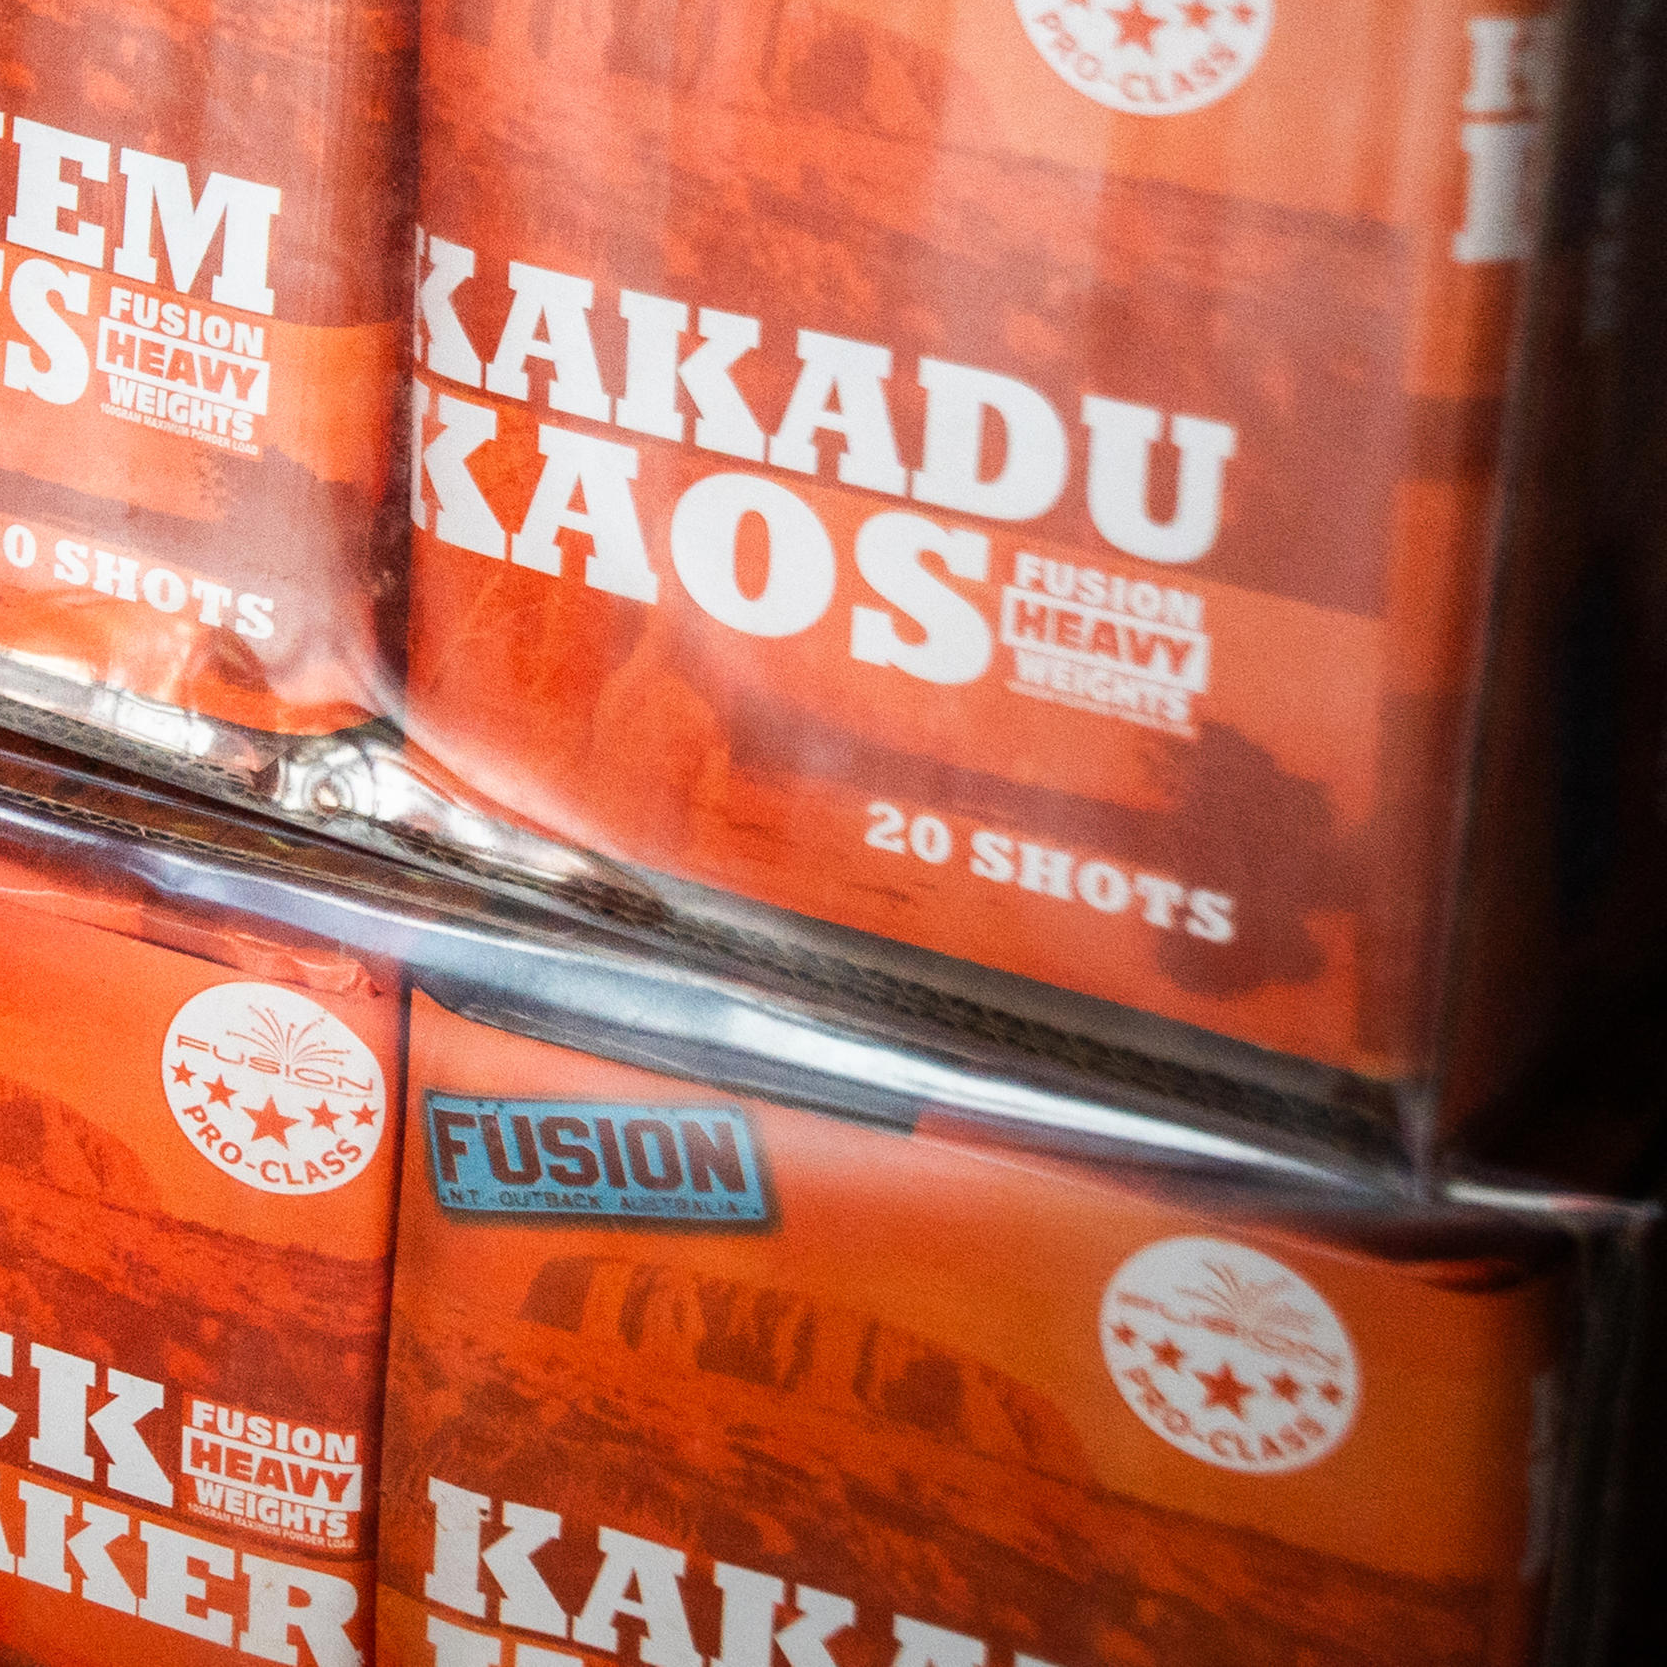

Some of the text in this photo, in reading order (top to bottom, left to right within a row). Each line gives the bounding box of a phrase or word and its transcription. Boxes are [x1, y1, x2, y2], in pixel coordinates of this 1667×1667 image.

[1034, 11, 1238, 104] PRO-CLASS
[109, 285, 265, 359] FUSION
[104, 328, 261, 402] HEAVY
[413, 224, 1238, 564] KAKADU
[107, 373, 254, 442] WEIGHTS
[410, 375, 995, 686] KAOS
[52, 540, 276, 642] SHOTS
[1015, 551, 1204, 633] FUSION
[1014, 599, 1193, 677] HEAVY
[863, 801, 1238, 946] 20 SHOTS
[176, 1033, 374, 1092] FUSION
[182, 1103, 363, 1186] PRO-CLASS
[432, 1107, 747, 1193] FUSION
[499, 1191, 602, 1210] OUTBACK
[620, 1195, 740, 1215] AUSTRALIA
[191, 1399, 356, 1463] FUSION
[1121, 1365, 1327, 1463] PRO-CLASS
[189, 1436, 355, 1503] HEAVY
[193, 1477, 348, 1539] WEIGHTS
[424, 1474, 1069, 1667] KAK
